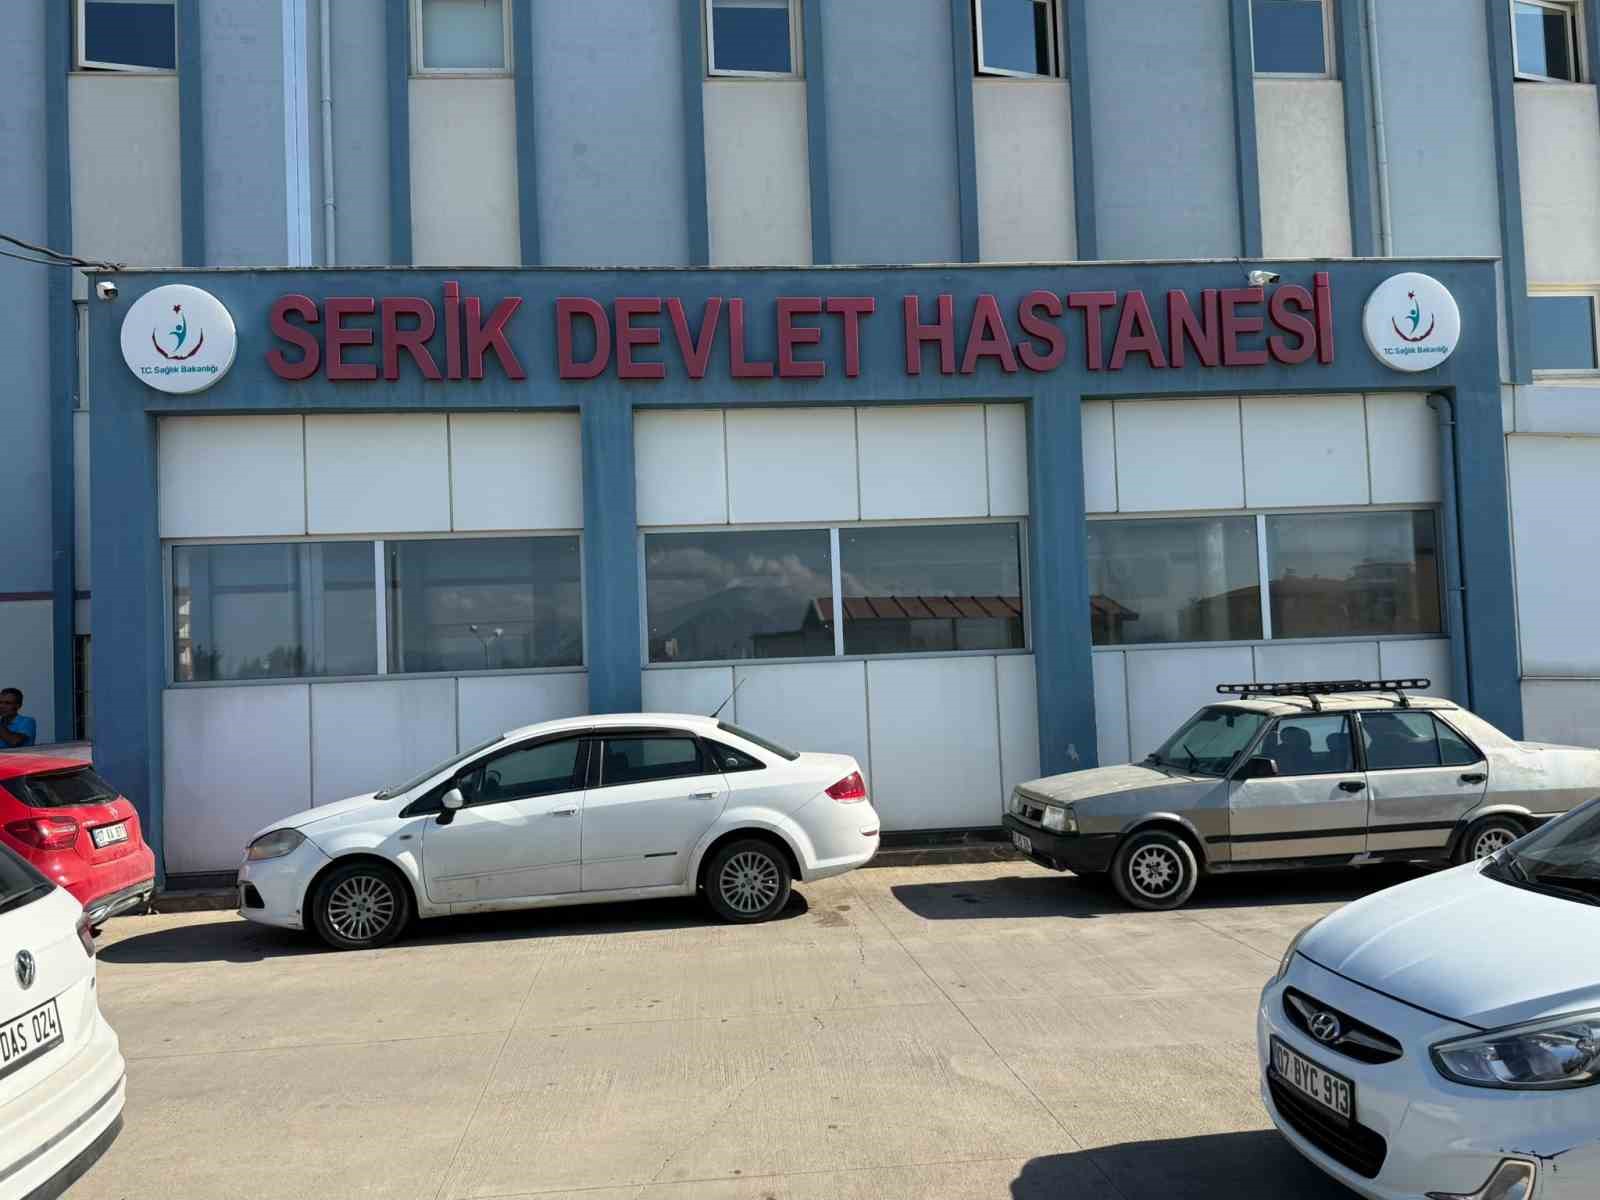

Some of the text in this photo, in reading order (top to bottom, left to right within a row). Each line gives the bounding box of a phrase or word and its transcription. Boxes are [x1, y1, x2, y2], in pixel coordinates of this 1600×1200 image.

[267, 271, 1334, 382] SERİK DEVLET HASTANESİ
[0, 1008, 57, 1062] DAS 024
[1279, 1047, 1349, 1114] 07 BYC 913
